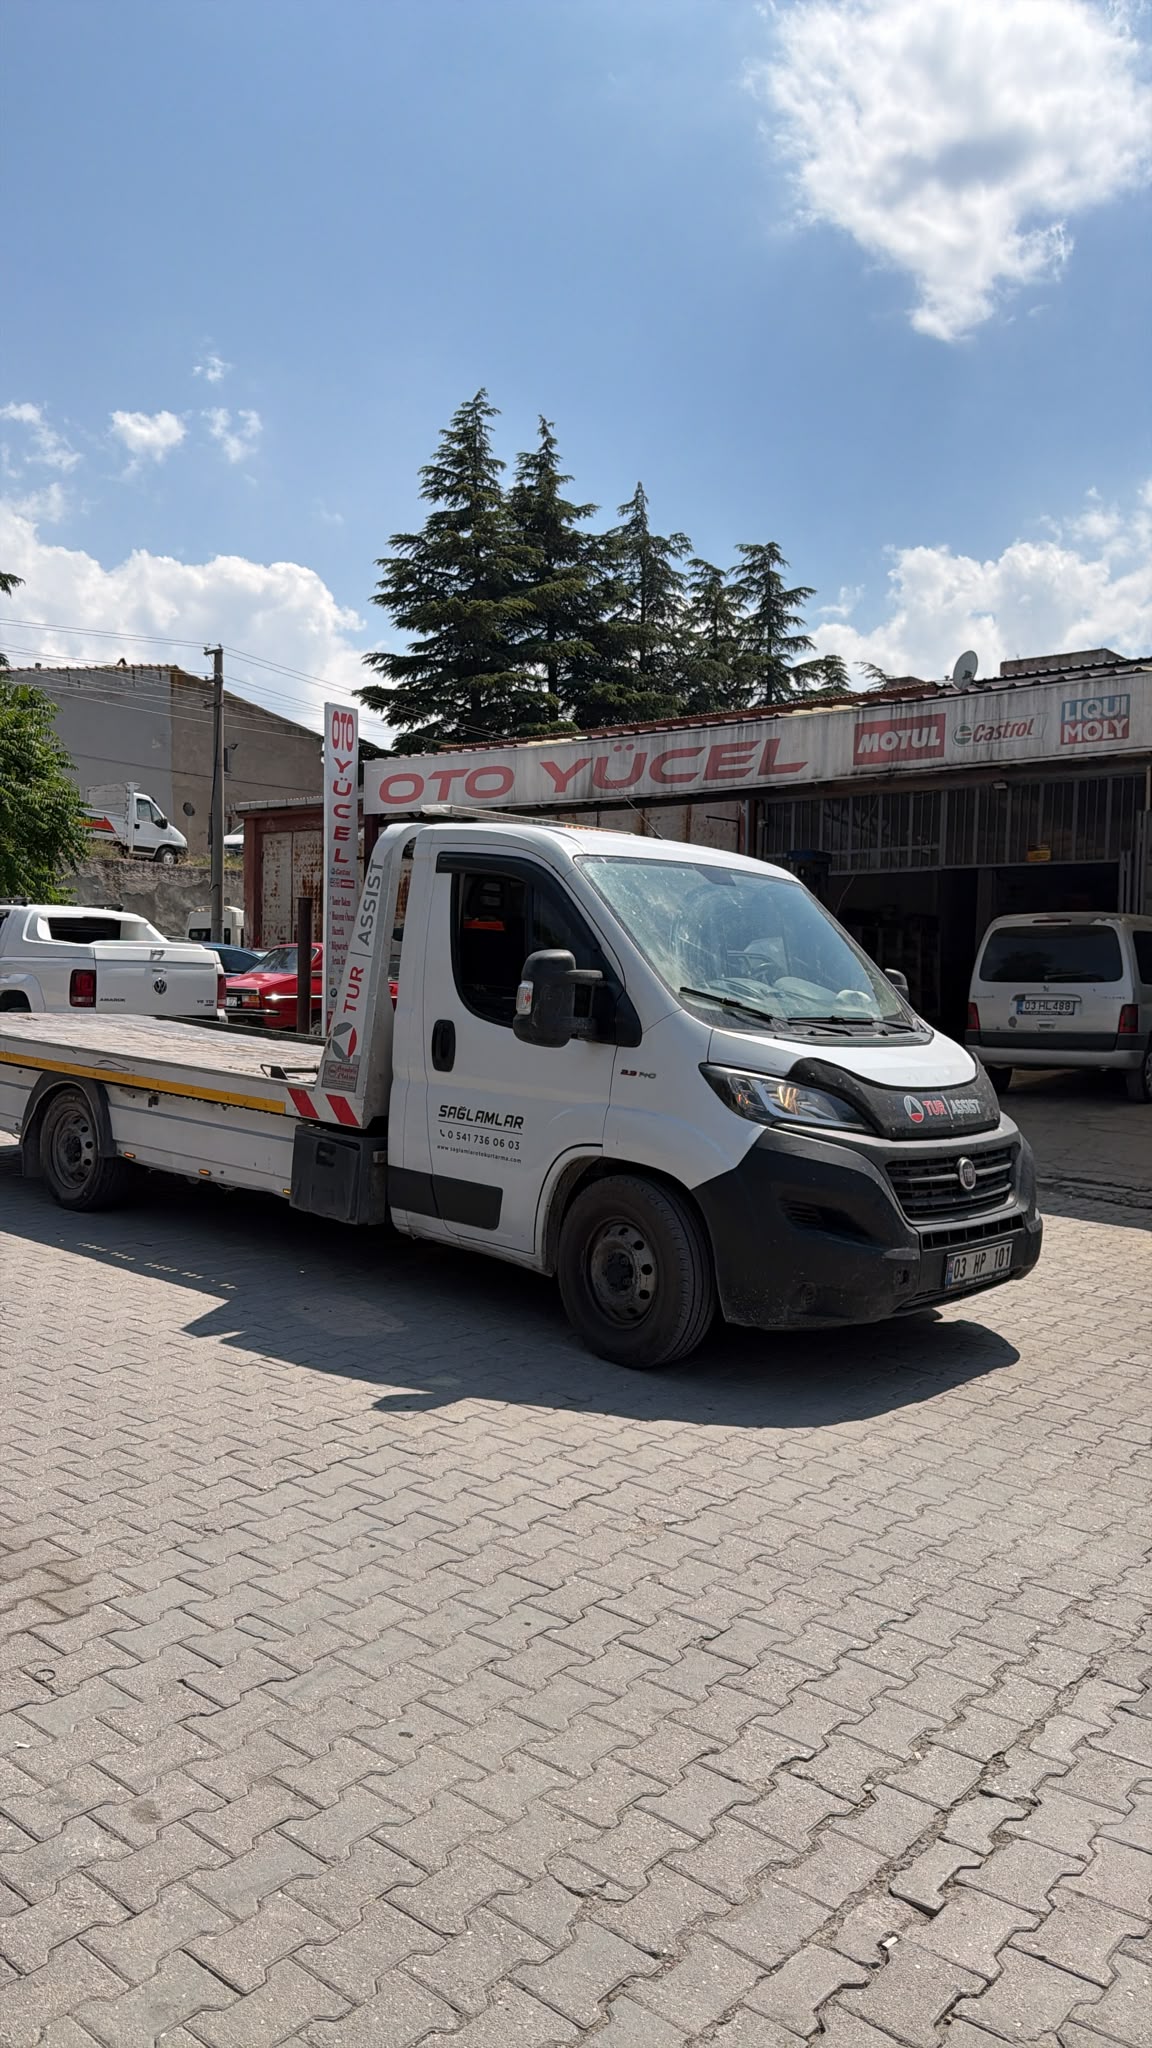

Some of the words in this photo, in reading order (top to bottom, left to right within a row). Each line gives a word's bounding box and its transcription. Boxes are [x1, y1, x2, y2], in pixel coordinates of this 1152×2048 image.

[1064, 696, 1128, 721] LIQUI
[332, 710, 354, 752] OTO
[857, 726, 940, 754] MOTUL
[972, 717, 1035, 743] Castrol
[1063, 718, 1128, 743] MOLY
[378, 766, 515, 804] OTO
[540, 738, 807, 793] YÜCEL
[333, 757, 352, 863] YÜCEL
[343, 966, 364, 1014] TUR
[358, 859, 384, 947] ASSIST
[1024, 1001, 1037, 1011] 03
[1038, 1001, 1052, 1011] HL
[438, 1105, 524, 1129] SAĞLAMLAR
[922, 1099, 947, 1116] TUR
[949, 1098, 981, 1115] ASSIST
[447, 1130, 454, 1139] 0
[456, 1131, 471, 1142] 541
[473, 1134, 490, 1145] 736
[492, 1137, 505, 1148] 06
[507, 1140, 520, 1151] 03
[953, 1256, 967, 1280] 03
[973, 1252, 987, 1275] HP
[994, 1246, 1010, 1269] 101
